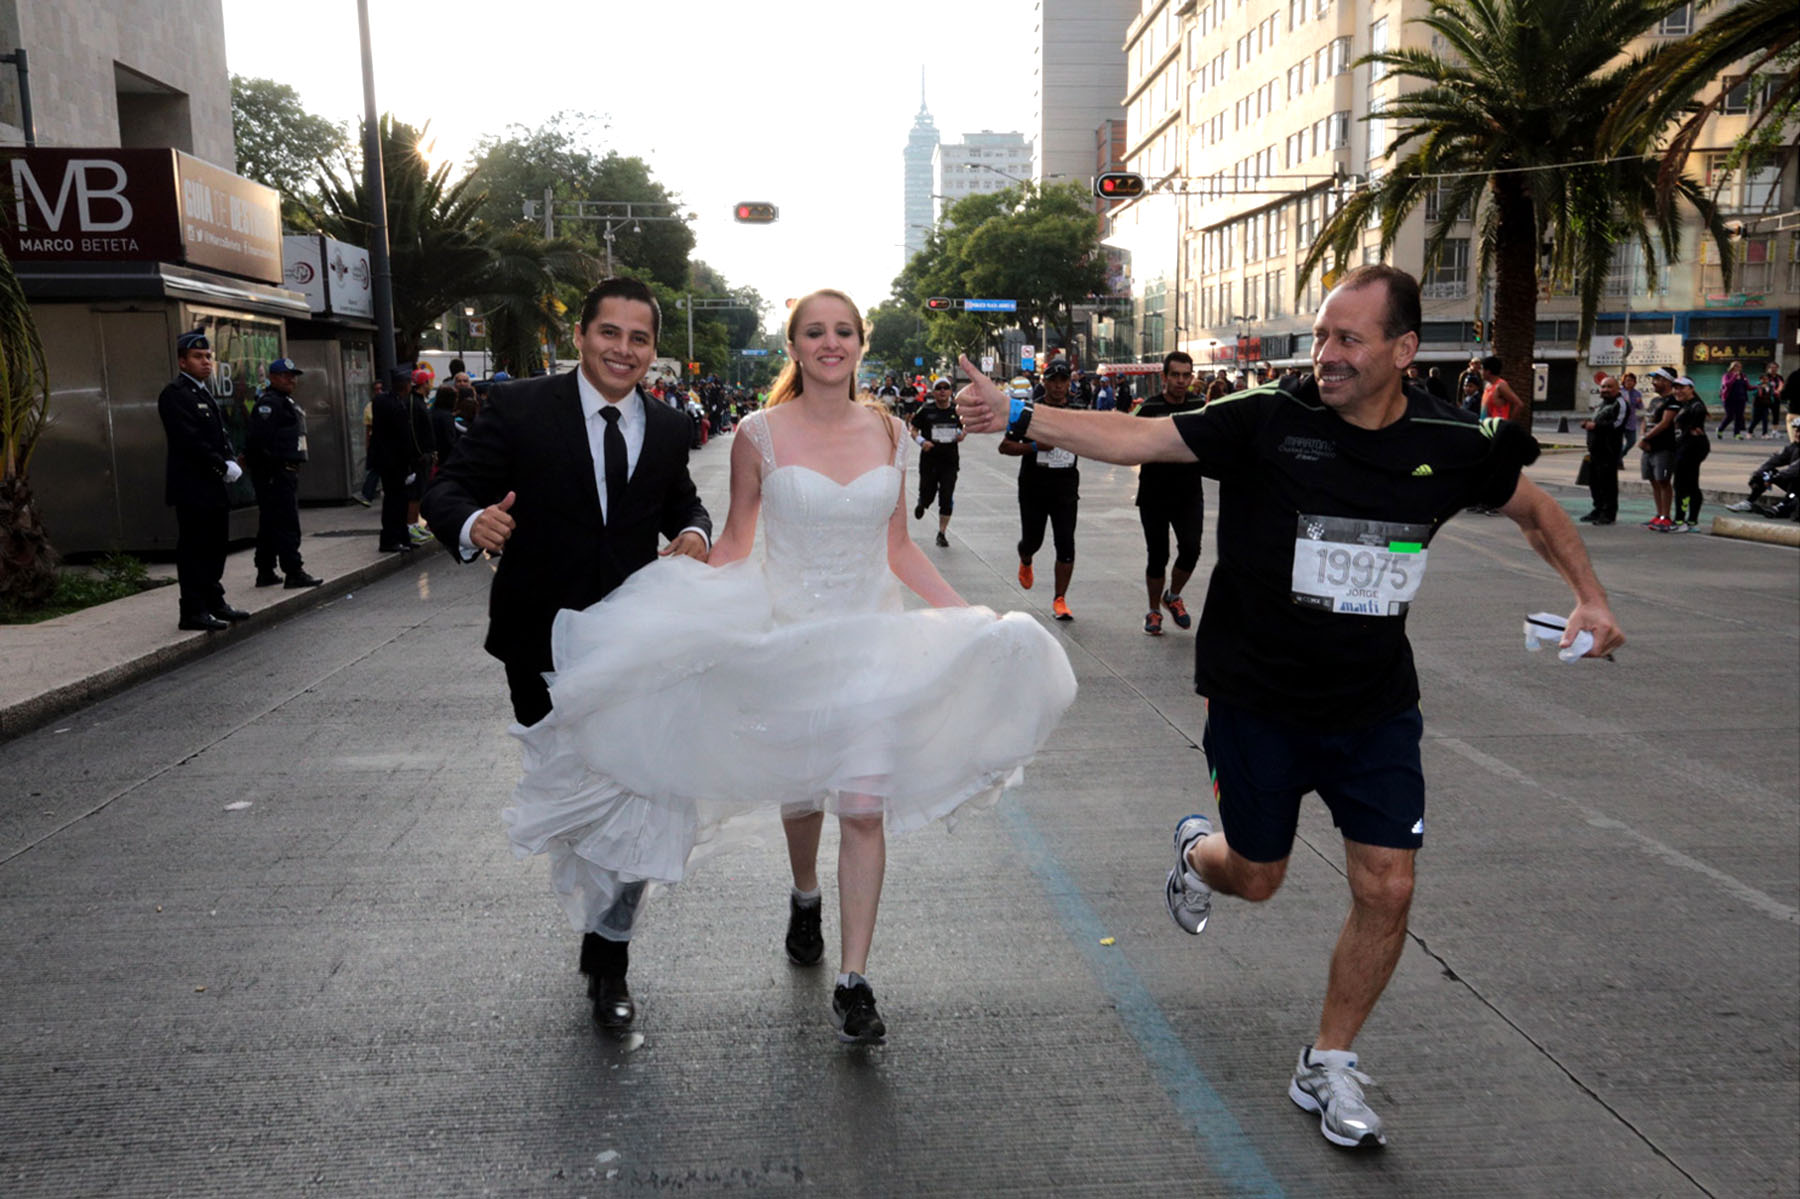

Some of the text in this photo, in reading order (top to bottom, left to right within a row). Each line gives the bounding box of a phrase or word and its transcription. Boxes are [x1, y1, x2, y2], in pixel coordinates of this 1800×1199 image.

[11, 159, 133, 232] MB
[20, 238, 139, 252] MARCO BETETA
[1316, 547, 1411, 590] 19975
[1345, 587, 1379, 598] JORGE
